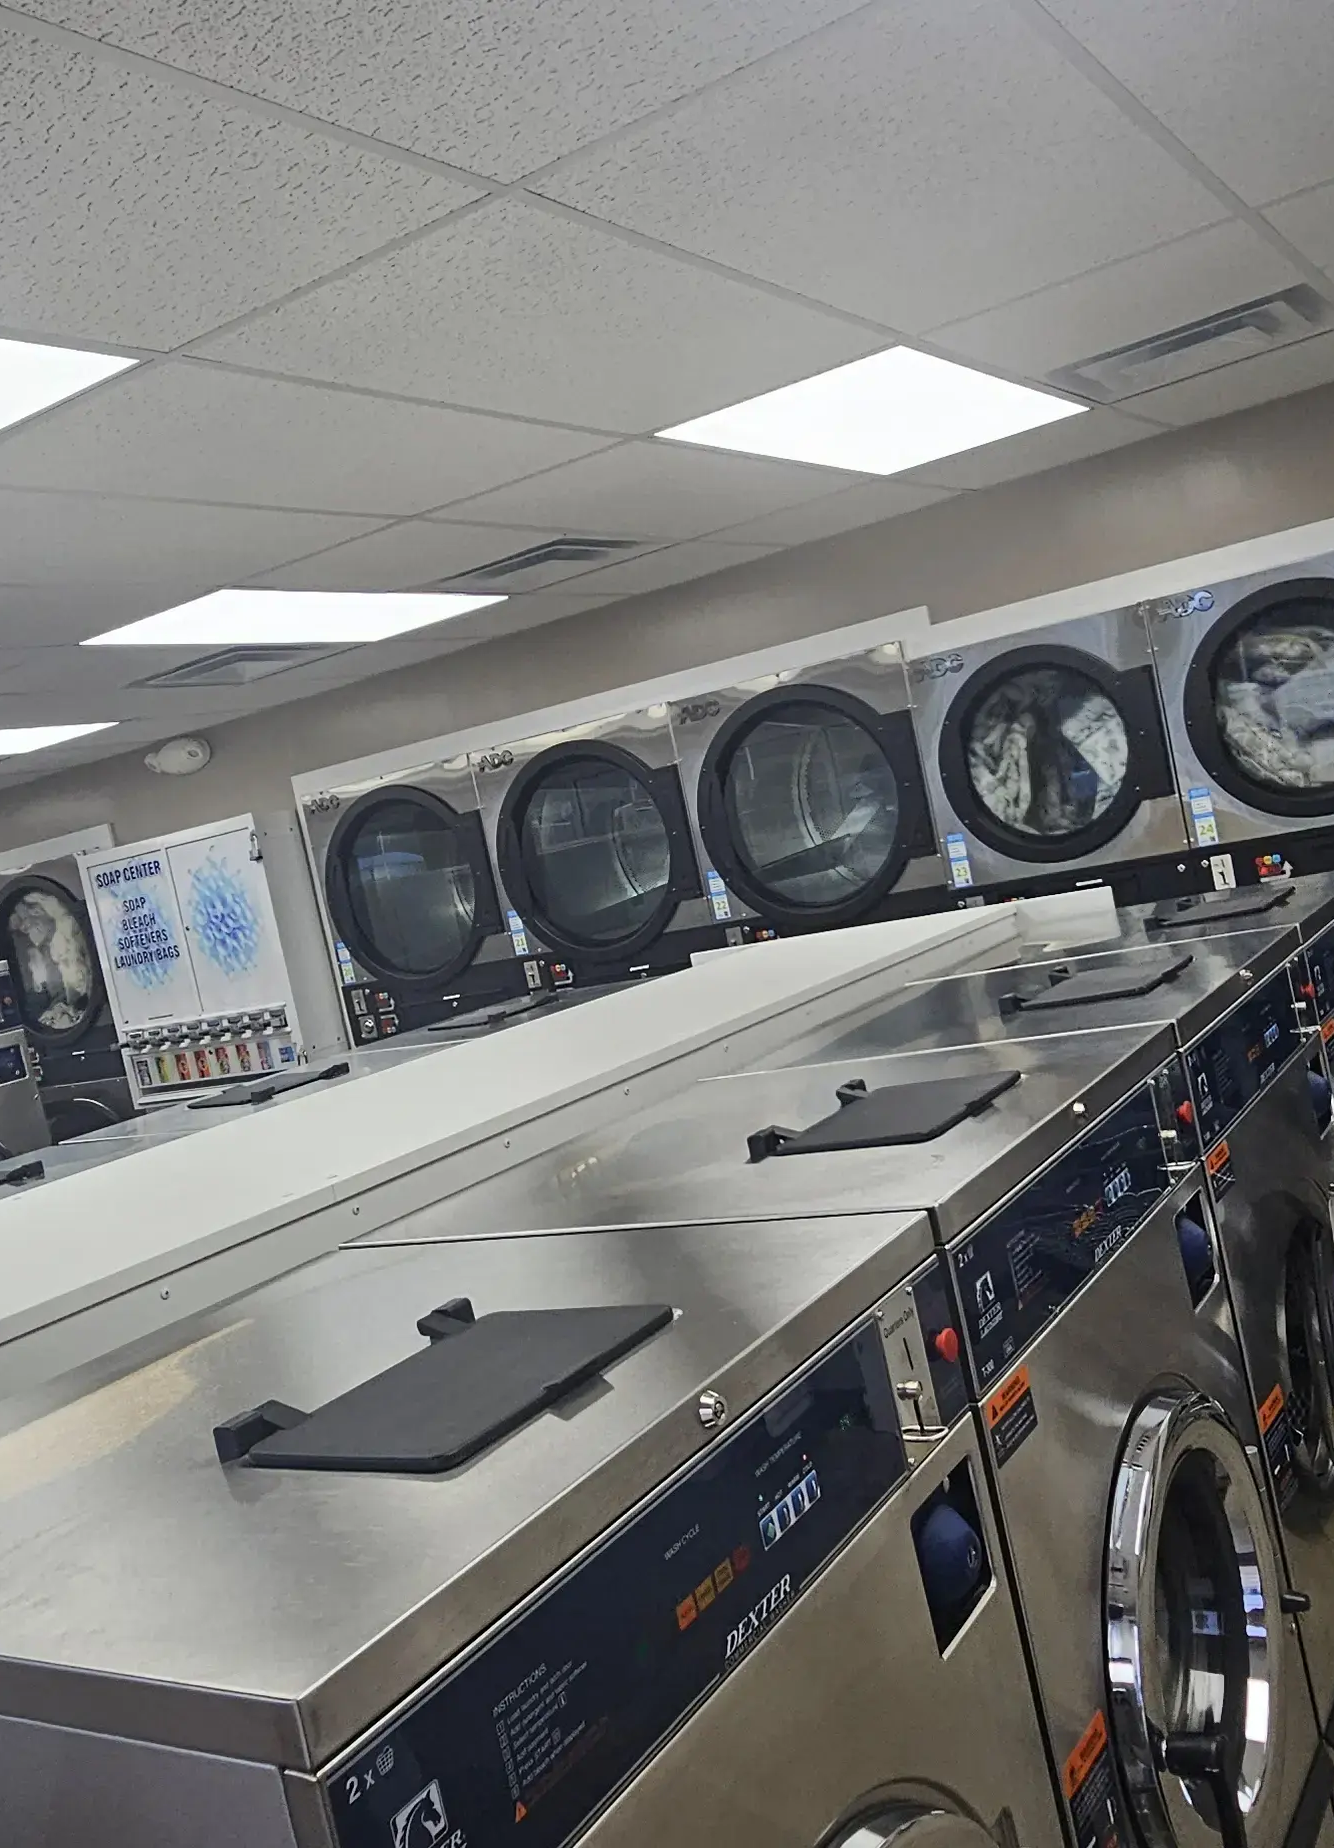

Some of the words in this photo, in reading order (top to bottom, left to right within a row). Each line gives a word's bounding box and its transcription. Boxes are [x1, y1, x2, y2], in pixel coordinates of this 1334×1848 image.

[475, 750, 515, 772] ADC
[1198, 824, 1214, 836] 24
[96, 869, 122, 888] SOAP
[122, 860, 162, 882] CENTER
[955, 867, 968, 877] 23
[123, 897, 147, 912] SOAP
[715, 901, 727, 910] 22
[122, 913, 157, 931] BLEACH
[118, 929, 169, 950] SOFTENERS
[114, 950, 154, 969] LAUNDRY
[155, 945, 181, 961] BAGS
[1094, 1225, 1123, 1263] DEXTER
[958, 1253, 965, 1268] 2
[664, 1539, 682, 1562] WASH
[680, 1523, 701, 1547] CYCLE
[724, 1572, 792, 1660] DEXTER
[492, 1662, 548, 1719] INSTRUCTIONS
[346, 1775, 362, 1805] 2
[363, 1769, 376, 1791] x
